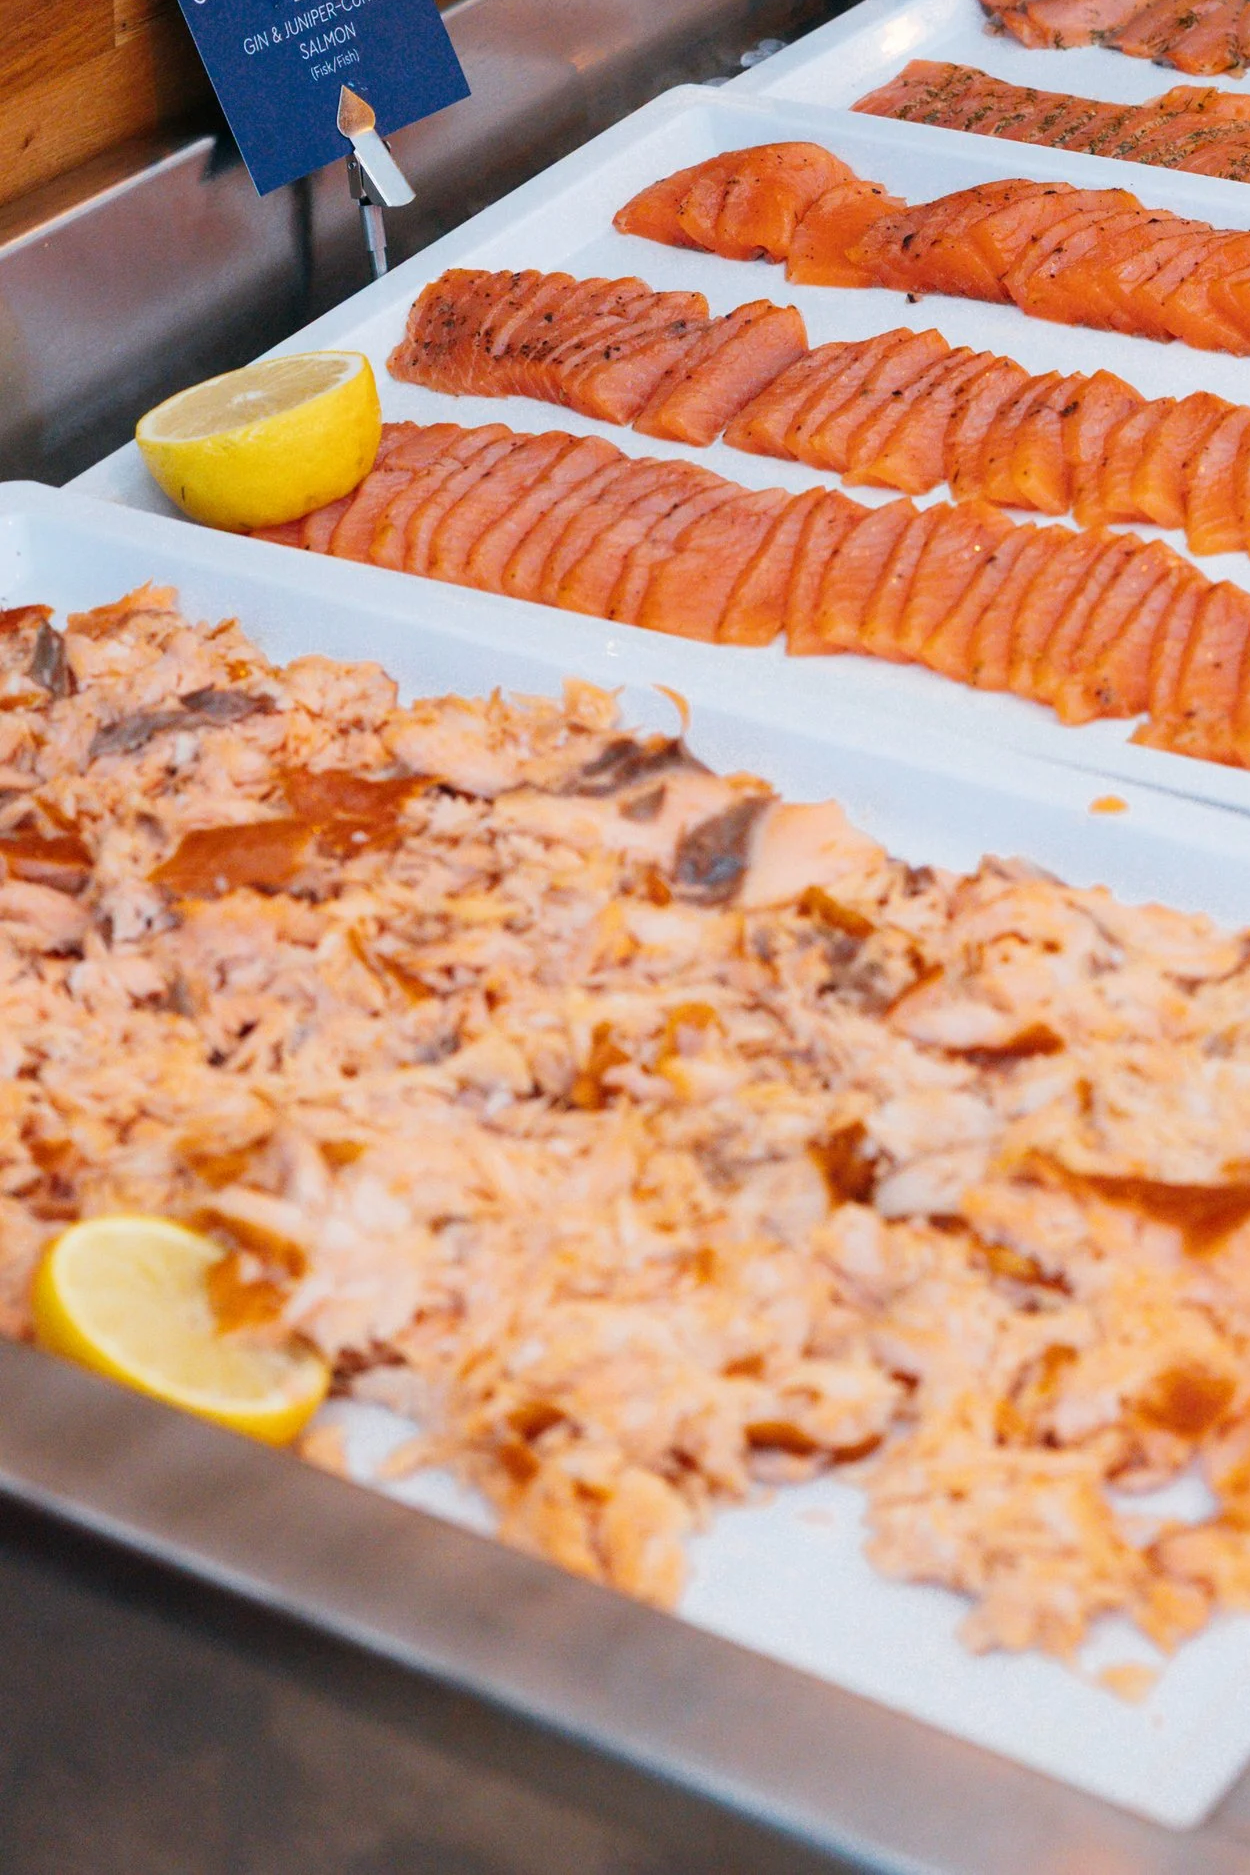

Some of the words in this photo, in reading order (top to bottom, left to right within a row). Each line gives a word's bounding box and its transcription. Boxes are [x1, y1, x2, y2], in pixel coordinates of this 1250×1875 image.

[243, 33, 269, 56] GIN
[272, 25, 283, 44] &
[299, 22, 356, 61] SALMON
[310, 48, 360, 82] (Fisk/Fish)
